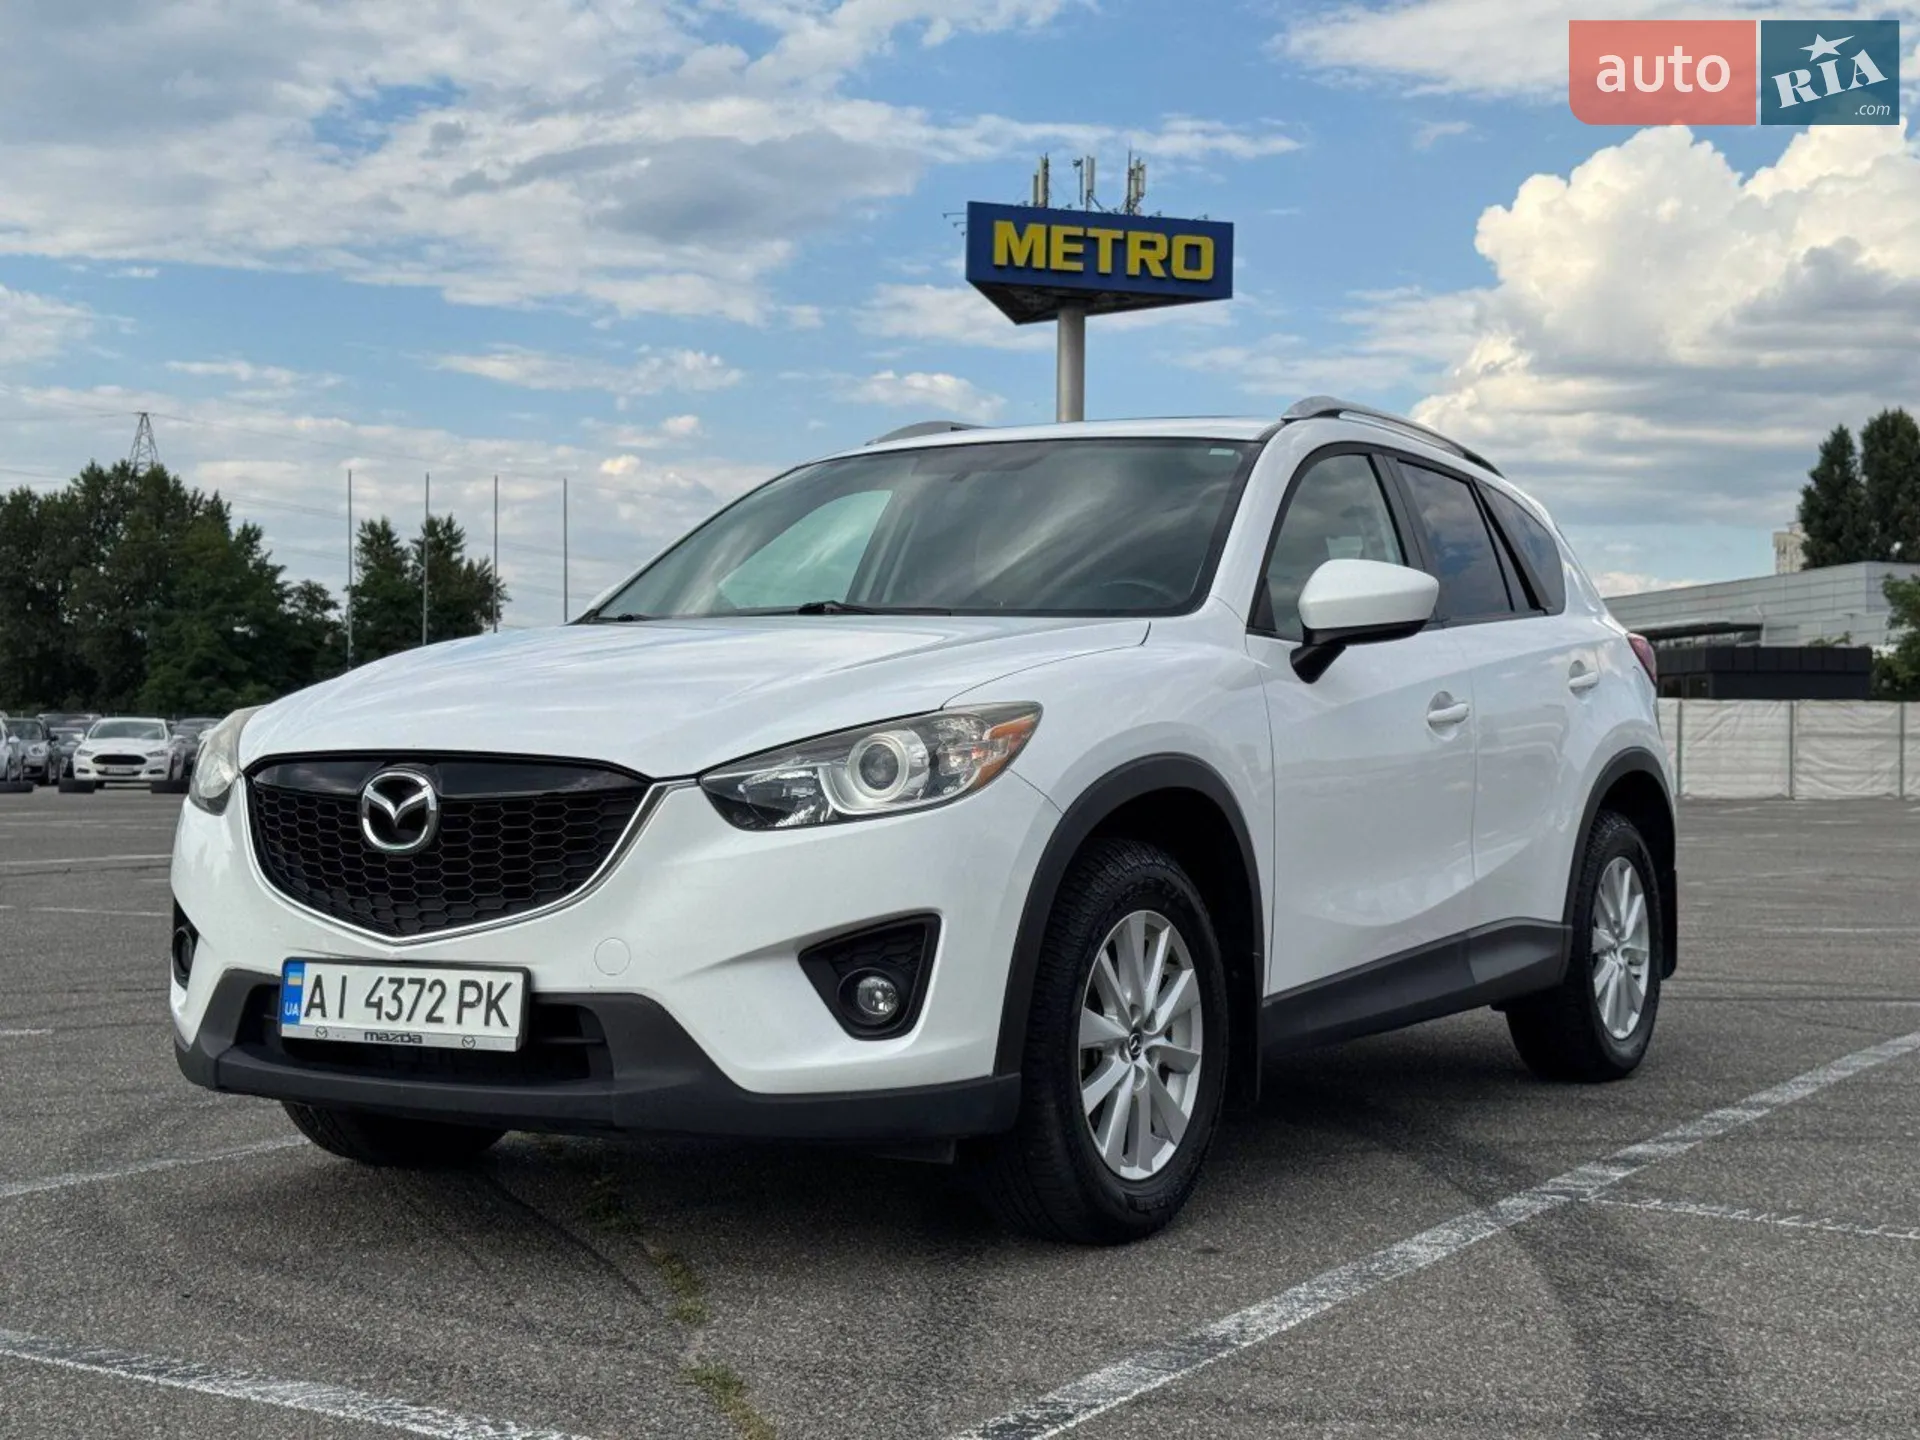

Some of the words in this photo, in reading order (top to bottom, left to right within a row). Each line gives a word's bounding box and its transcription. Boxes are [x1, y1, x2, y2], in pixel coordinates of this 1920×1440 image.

[993, 220, 1214, 281] METRO
[284, 1003, 299, 1017] UA
[304, 974, 348, 1019] AI
[364, 976, 447, 1024] 4372
[456, 980, 513, 1027] PK
[364, 1031, 423, 1045] mazda
